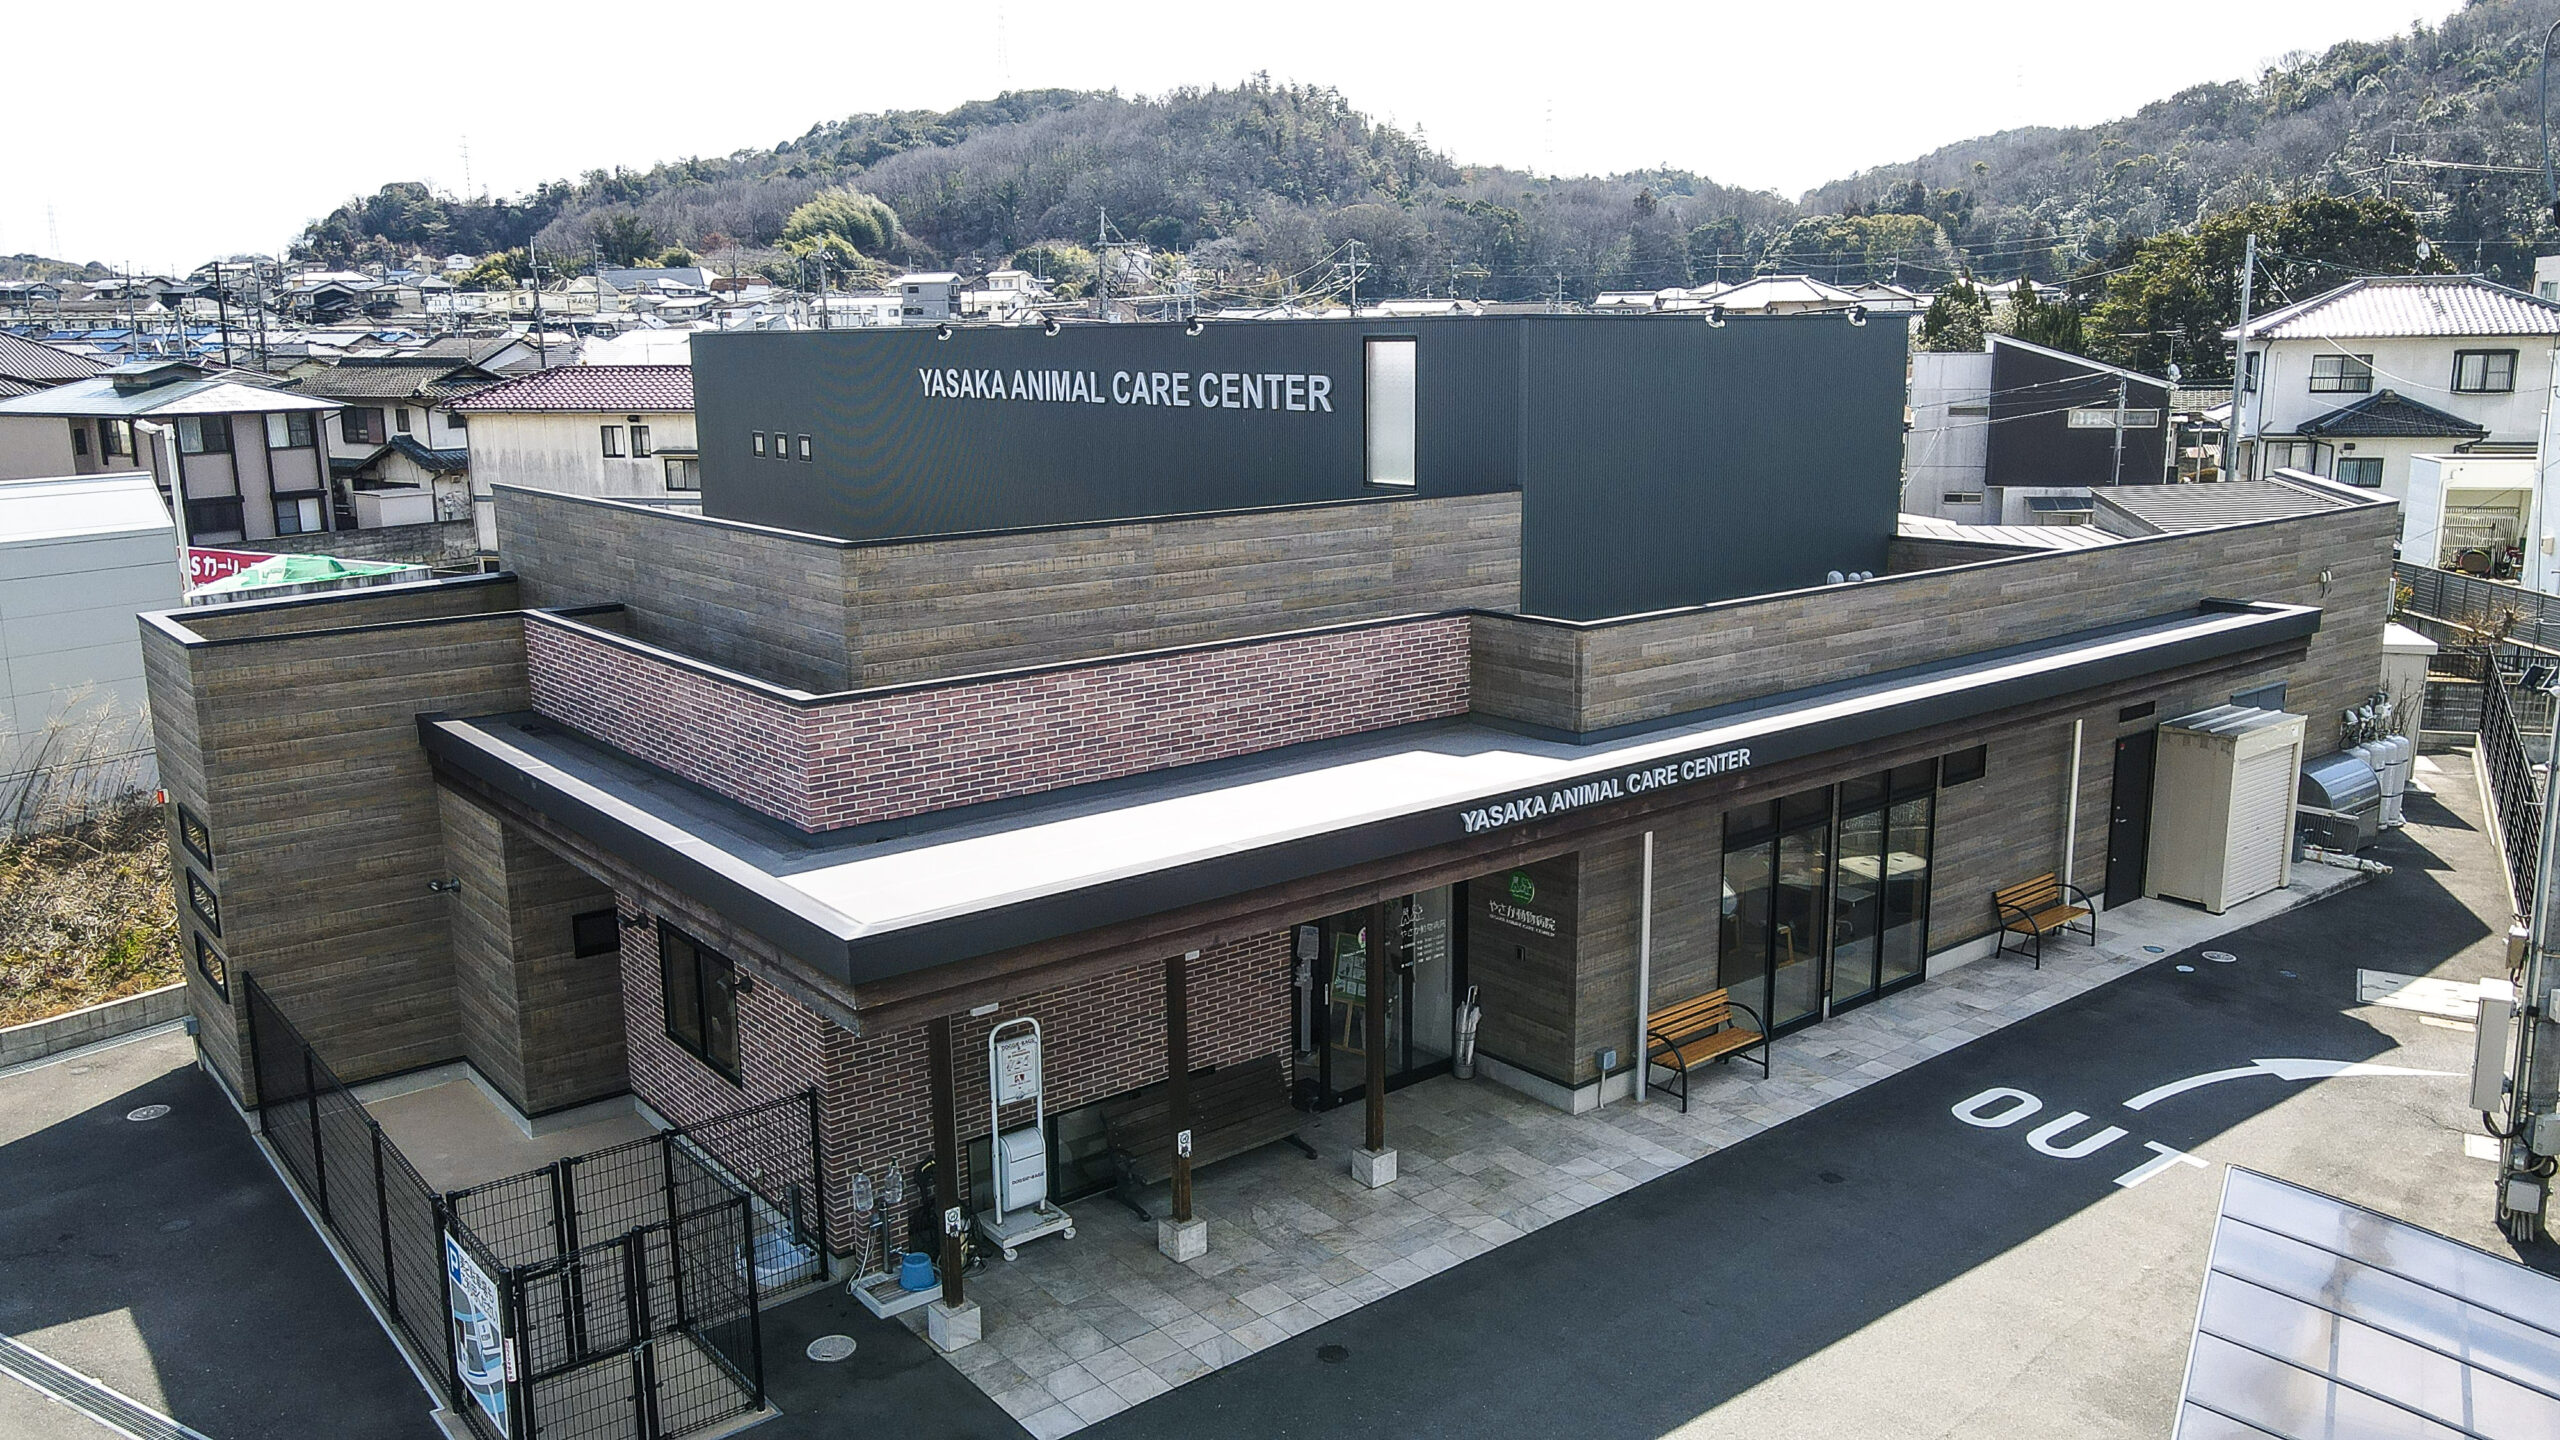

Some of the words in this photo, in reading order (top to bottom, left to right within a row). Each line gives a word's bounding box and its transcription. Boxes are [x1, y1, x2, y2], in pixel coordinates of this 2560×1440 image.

[919, 368, 1007, 399] YASAKA
[1010, 370, 1106, 403] ANIMAL
[1113, 371, 1190, 406] CARE
[1199, 372, 1334, 412] CENTER
[1461, 796, 1547, 832] YASAKA
[1549, 779, 1624, 813] ANIMAL
[1626, 764, 1678, 793] CARE
[1681, 748, 1750, 780] CENTER
[1952, 1087, 2210, 1189] OUT
[449, 1246, 459, 1273] P
